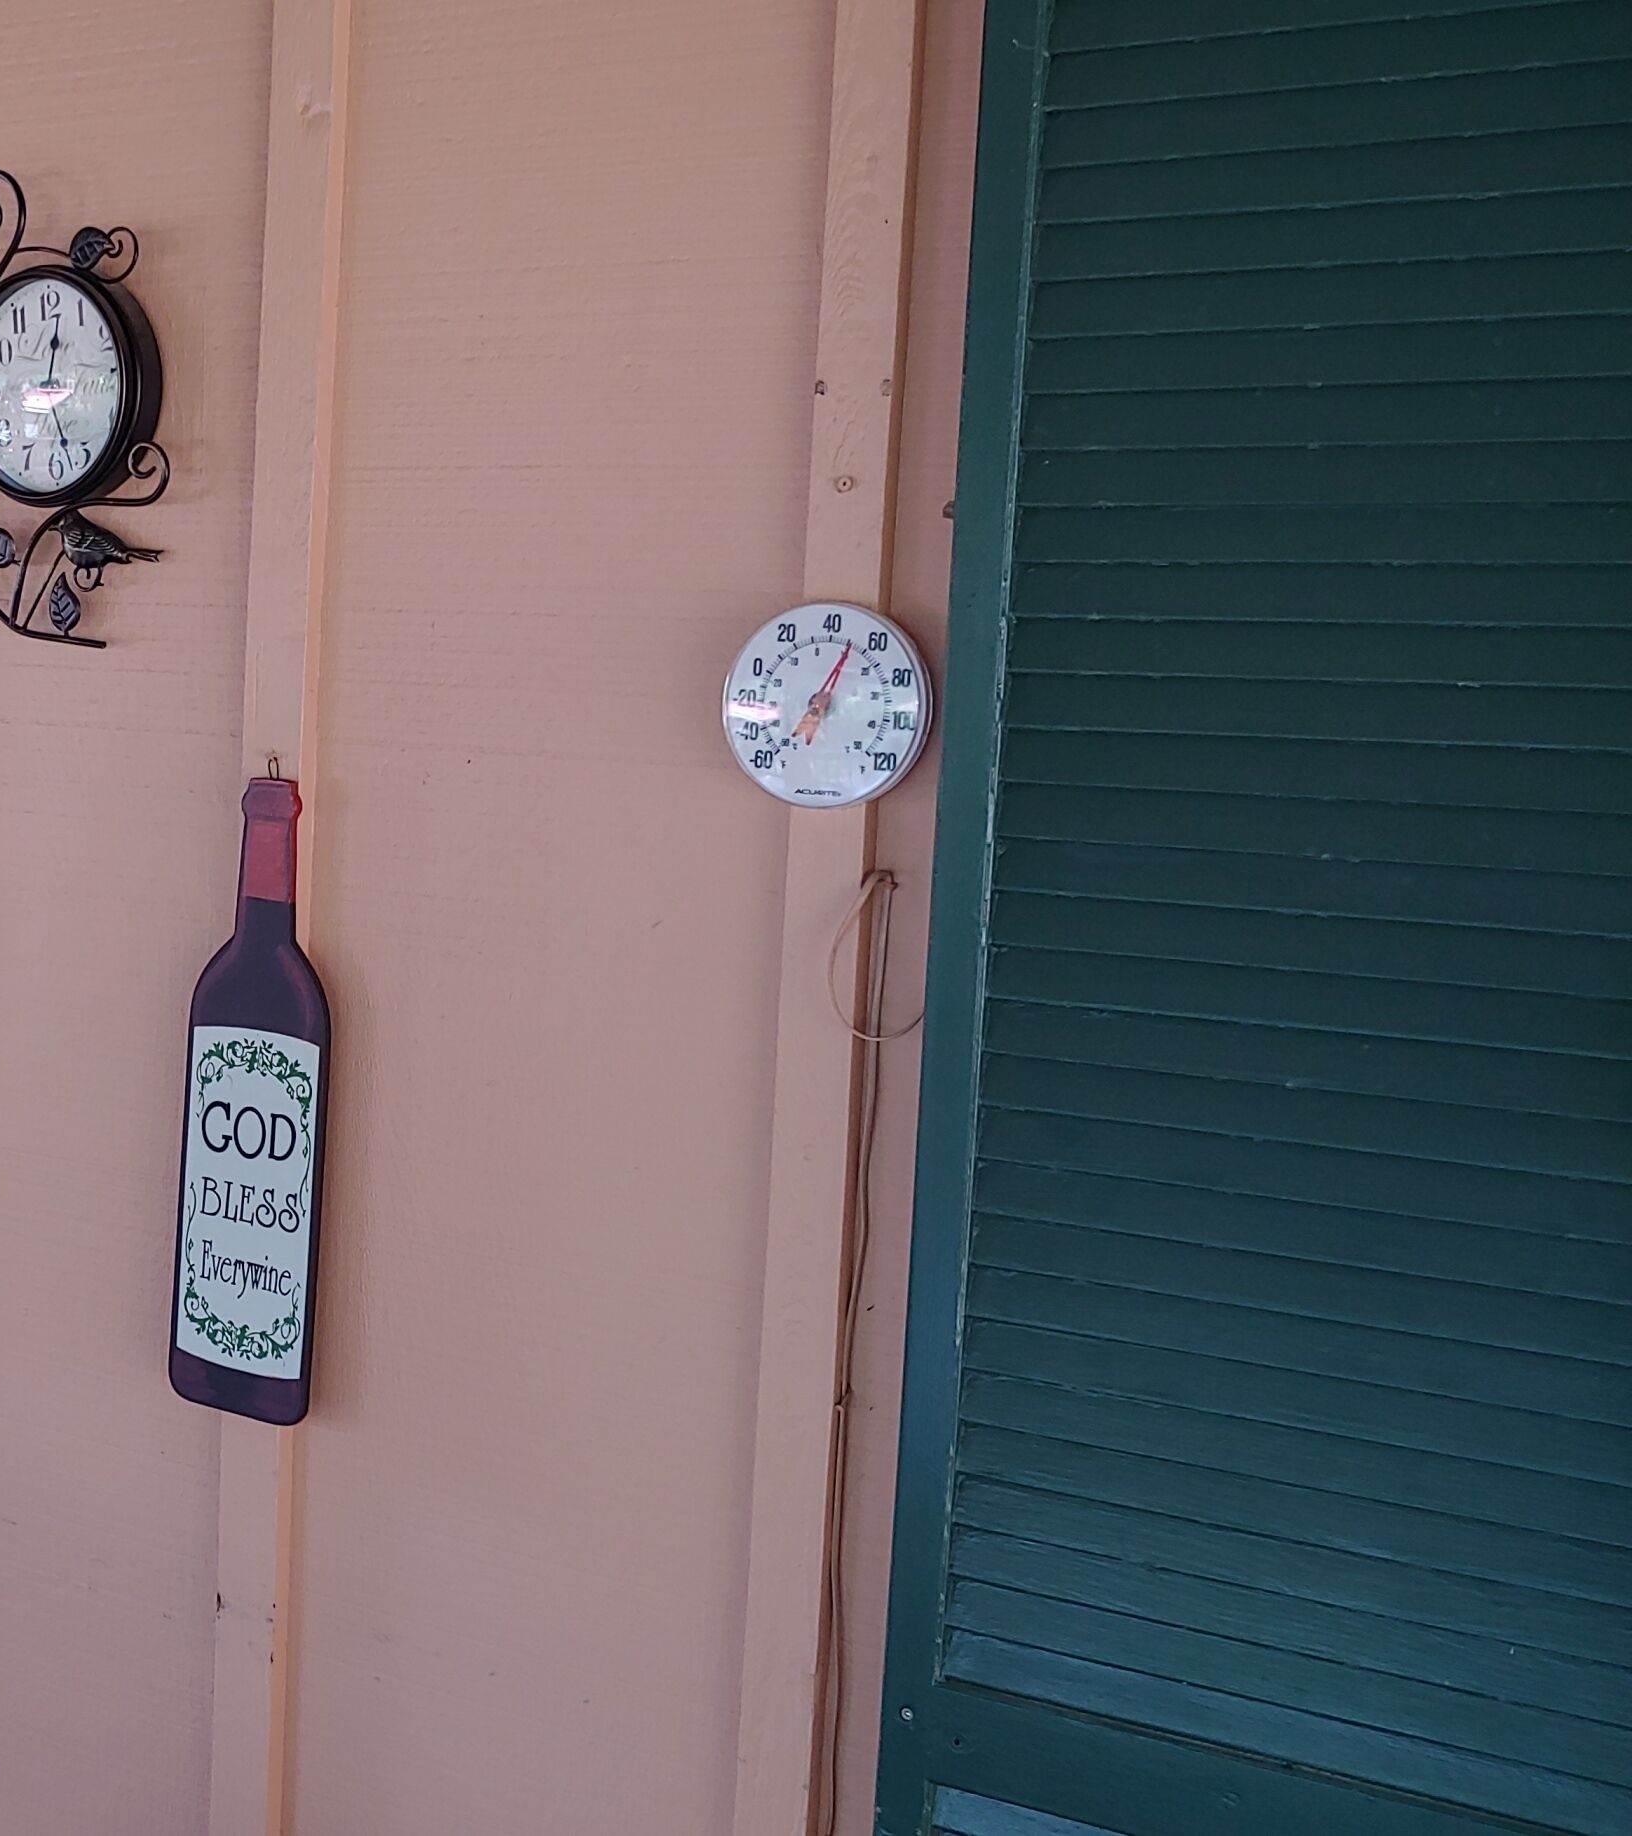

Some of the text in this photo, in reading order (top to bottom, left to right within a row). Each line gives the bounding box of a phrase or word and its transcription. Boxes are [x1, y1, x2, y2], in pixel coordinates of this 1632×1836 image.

[39, 290, 61, 321] 12
[77, 299, 84, 326] 1
[11, 305, 26, 334] 11
[22, 442, 35, 471] 7
[48, 452, 64, 480] 6
[74, 442, 91, 469] 5
[777, 624, 796, 642] 20
[823, 614, 841, 632] 40
[869, 632, 888, 651] 60
[753, 658, 763, 676] 0
[892, 669, 912, 687] 80
[733, 690, 756, 708] -20
[736, 722, 759, 740] -40
[749, 751, 773, 768] -60
[873, 753, 896, 771] 120
[201, 1101, 297, 1161] GOD
[200, 1176, 301, 1233] BLESS
[200, 1239, 292, 1299] Everywine
